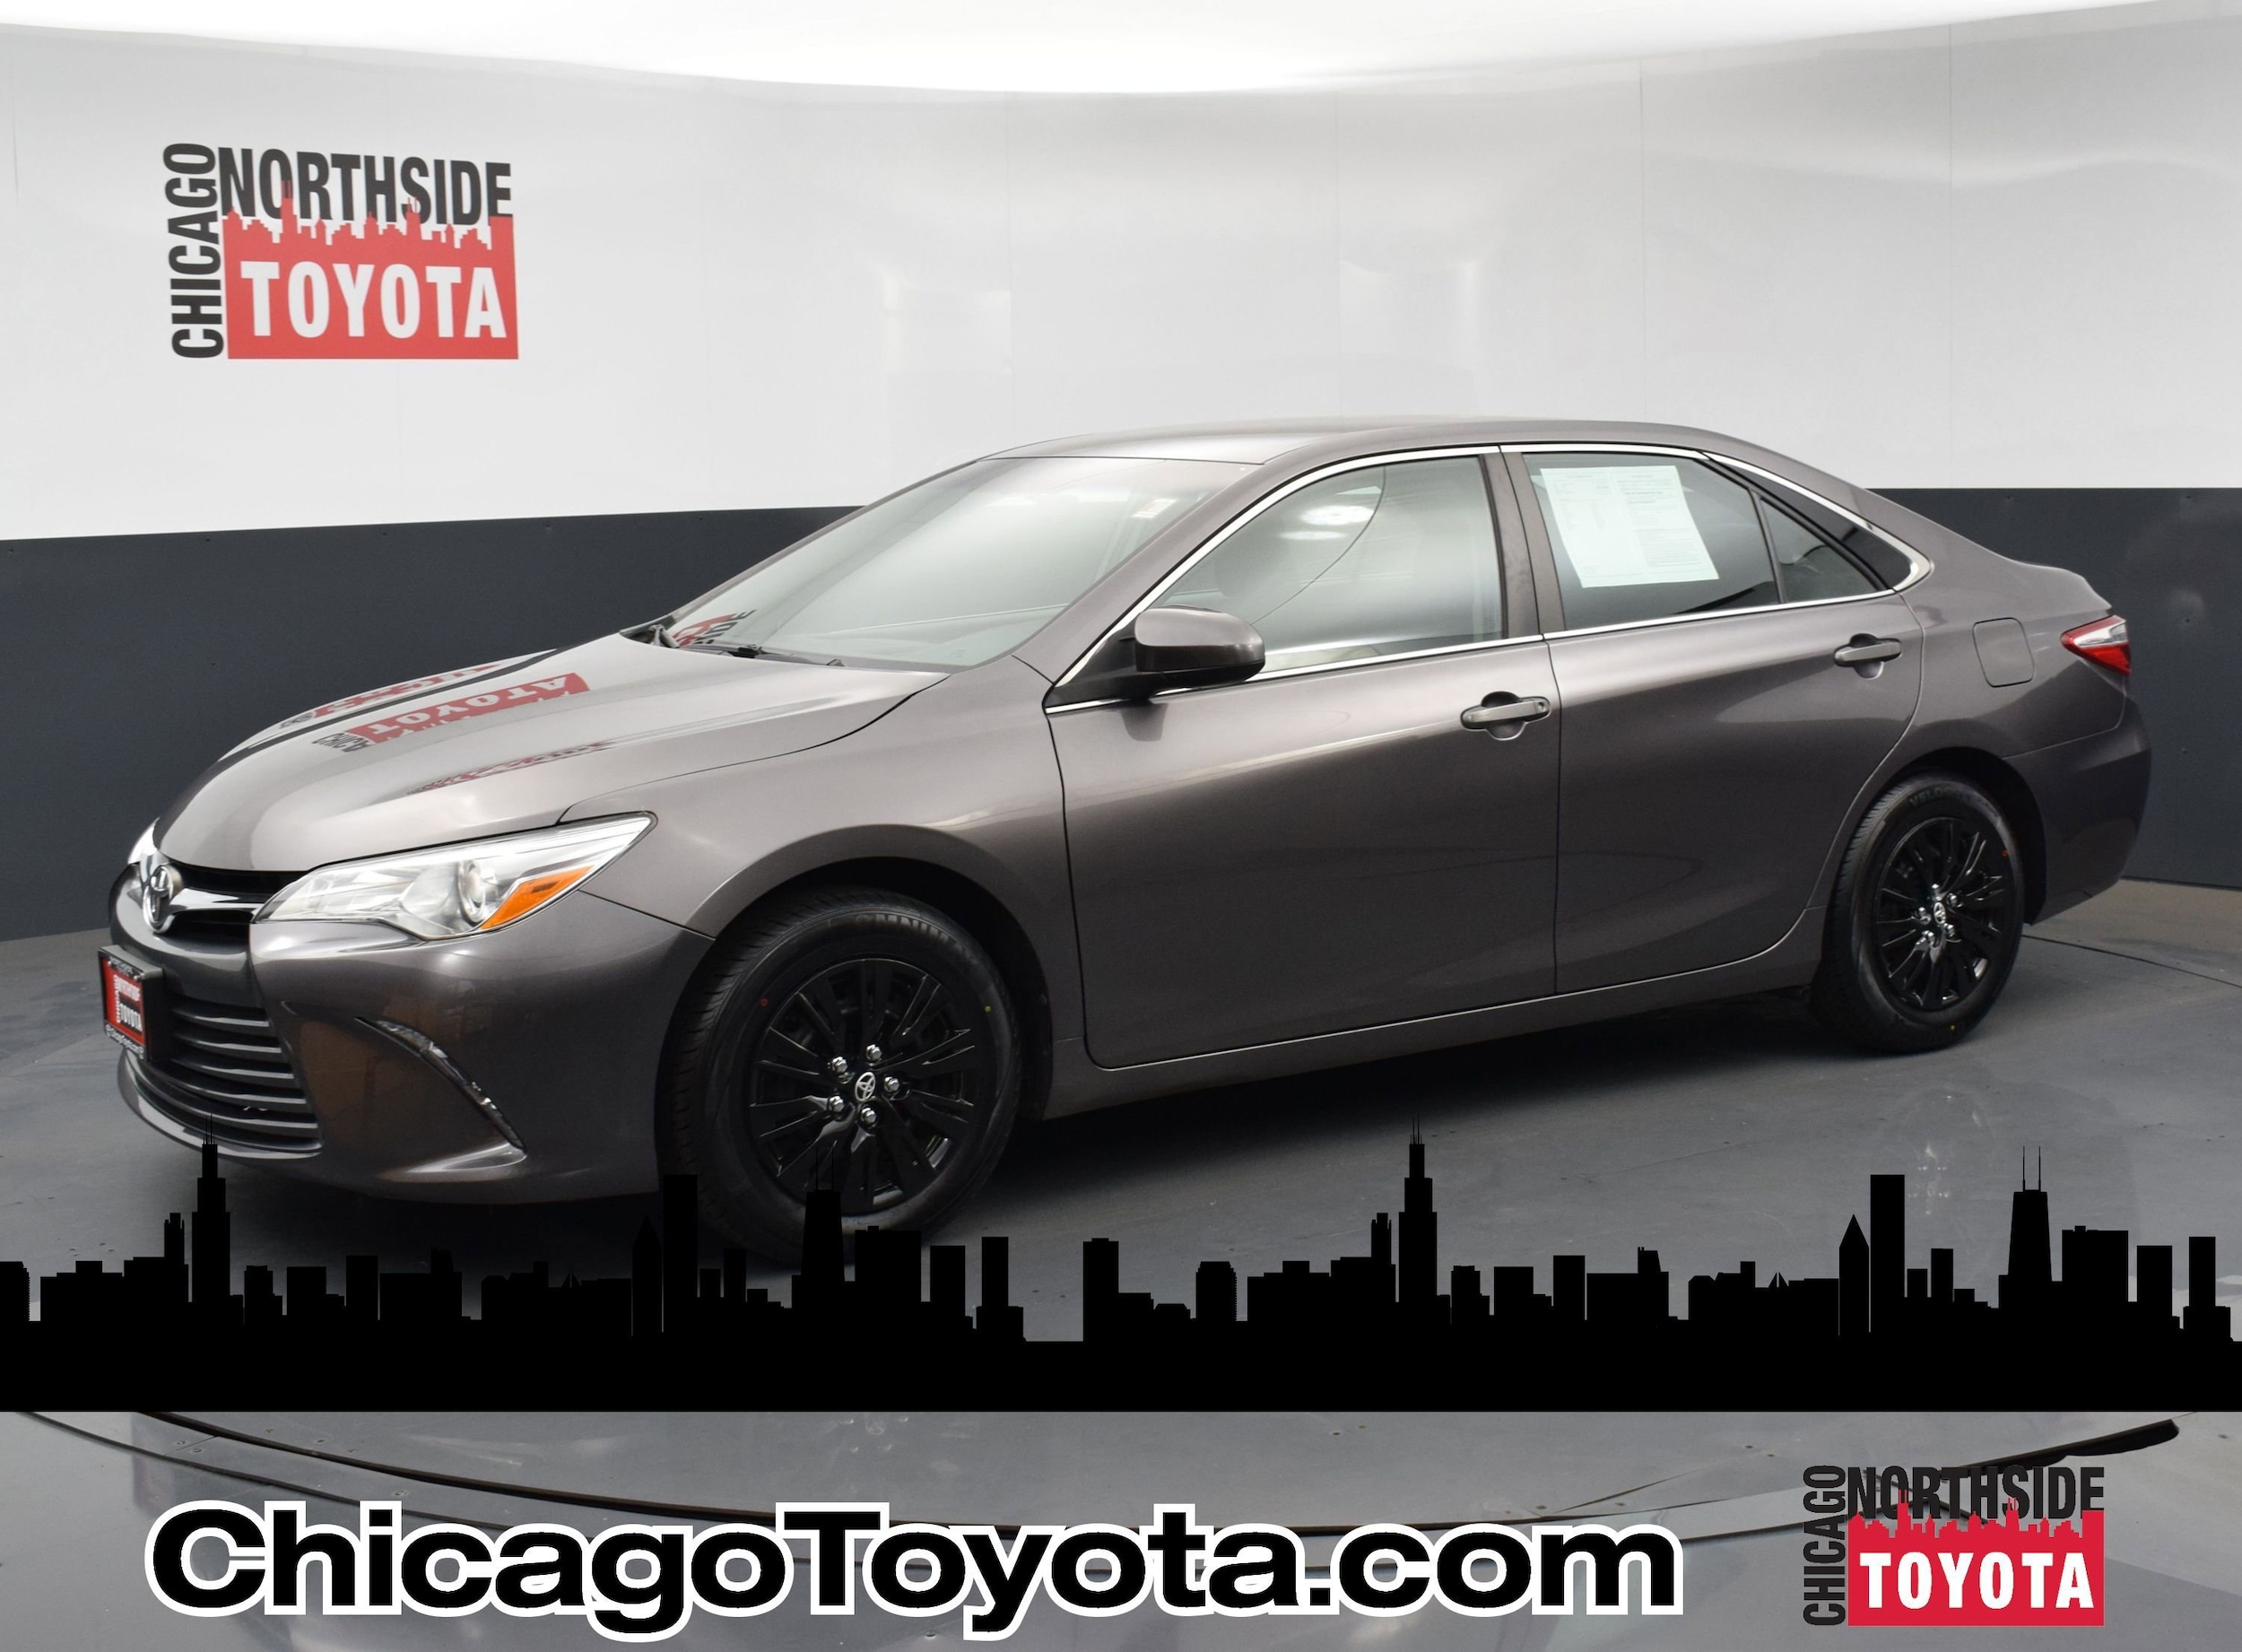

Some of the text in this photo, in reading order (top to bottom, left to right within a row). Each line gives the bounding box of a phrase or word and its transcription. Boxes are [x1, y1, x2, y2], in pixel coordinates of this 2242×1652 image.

[218, 147, 514, 225] NORTHSIDE
[163, 143, 224, 358] CHICAGO
[240, 260, 508, 339] TOYOTA
